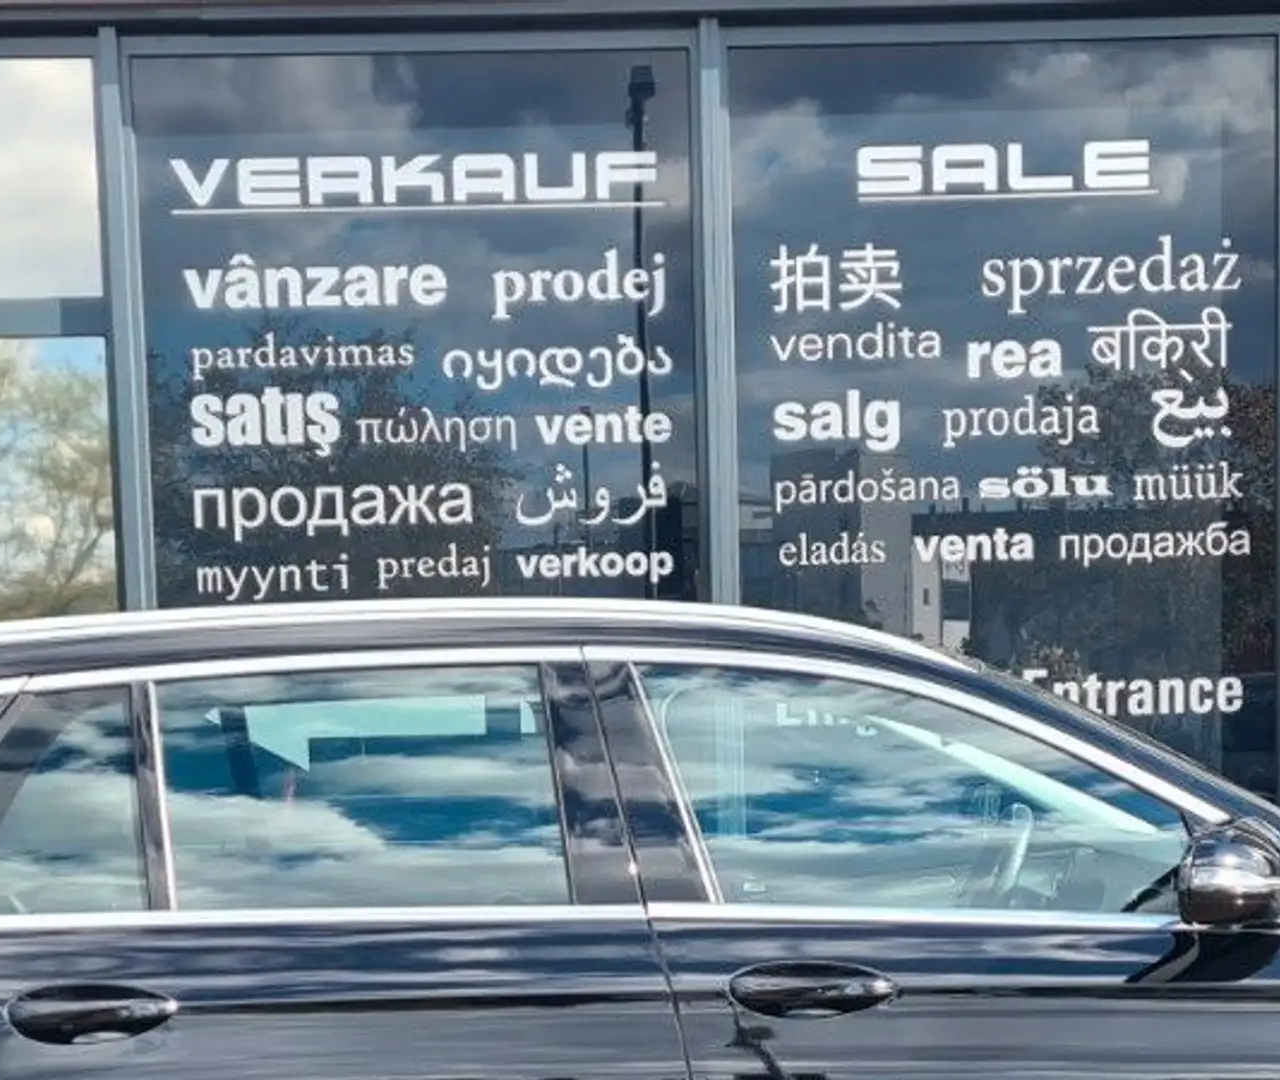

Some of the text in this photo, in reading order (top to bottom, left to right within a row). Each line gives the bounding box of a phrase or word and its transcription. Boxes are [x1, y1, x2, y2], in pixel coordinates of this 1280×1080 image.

[170, 151, 658, 207] VERKAUF
[857, 139, 1151, 195] SALE
[185, 248, 667, 319] vânzare prodej
[771, 244, 901, 312] 拍卖
[981, 235, 1242, 314] sprzedaż
[192, 332, 413, 381] pardavimas
[443, 335, 671, 390] იყიდება
[771, 323, 1061, 378] vendita rea
[191, 388, 340, 456] satış
[356, 407, 516, 452] πώληση
[536, 406, 670, 444] vente
[774, 390, 1099, 451] salg prodaja
[194, 483, 472, 541] продажа
[516, 462, 665, 525] فروش
[776, 462, 1242, 513] pārdošana sölu müük
[198, 543, 672, 600] myynti predaj verkoop
[780, 529, 1033, 565] eladás venta
[1061, 522, 1249, 567] продажба
